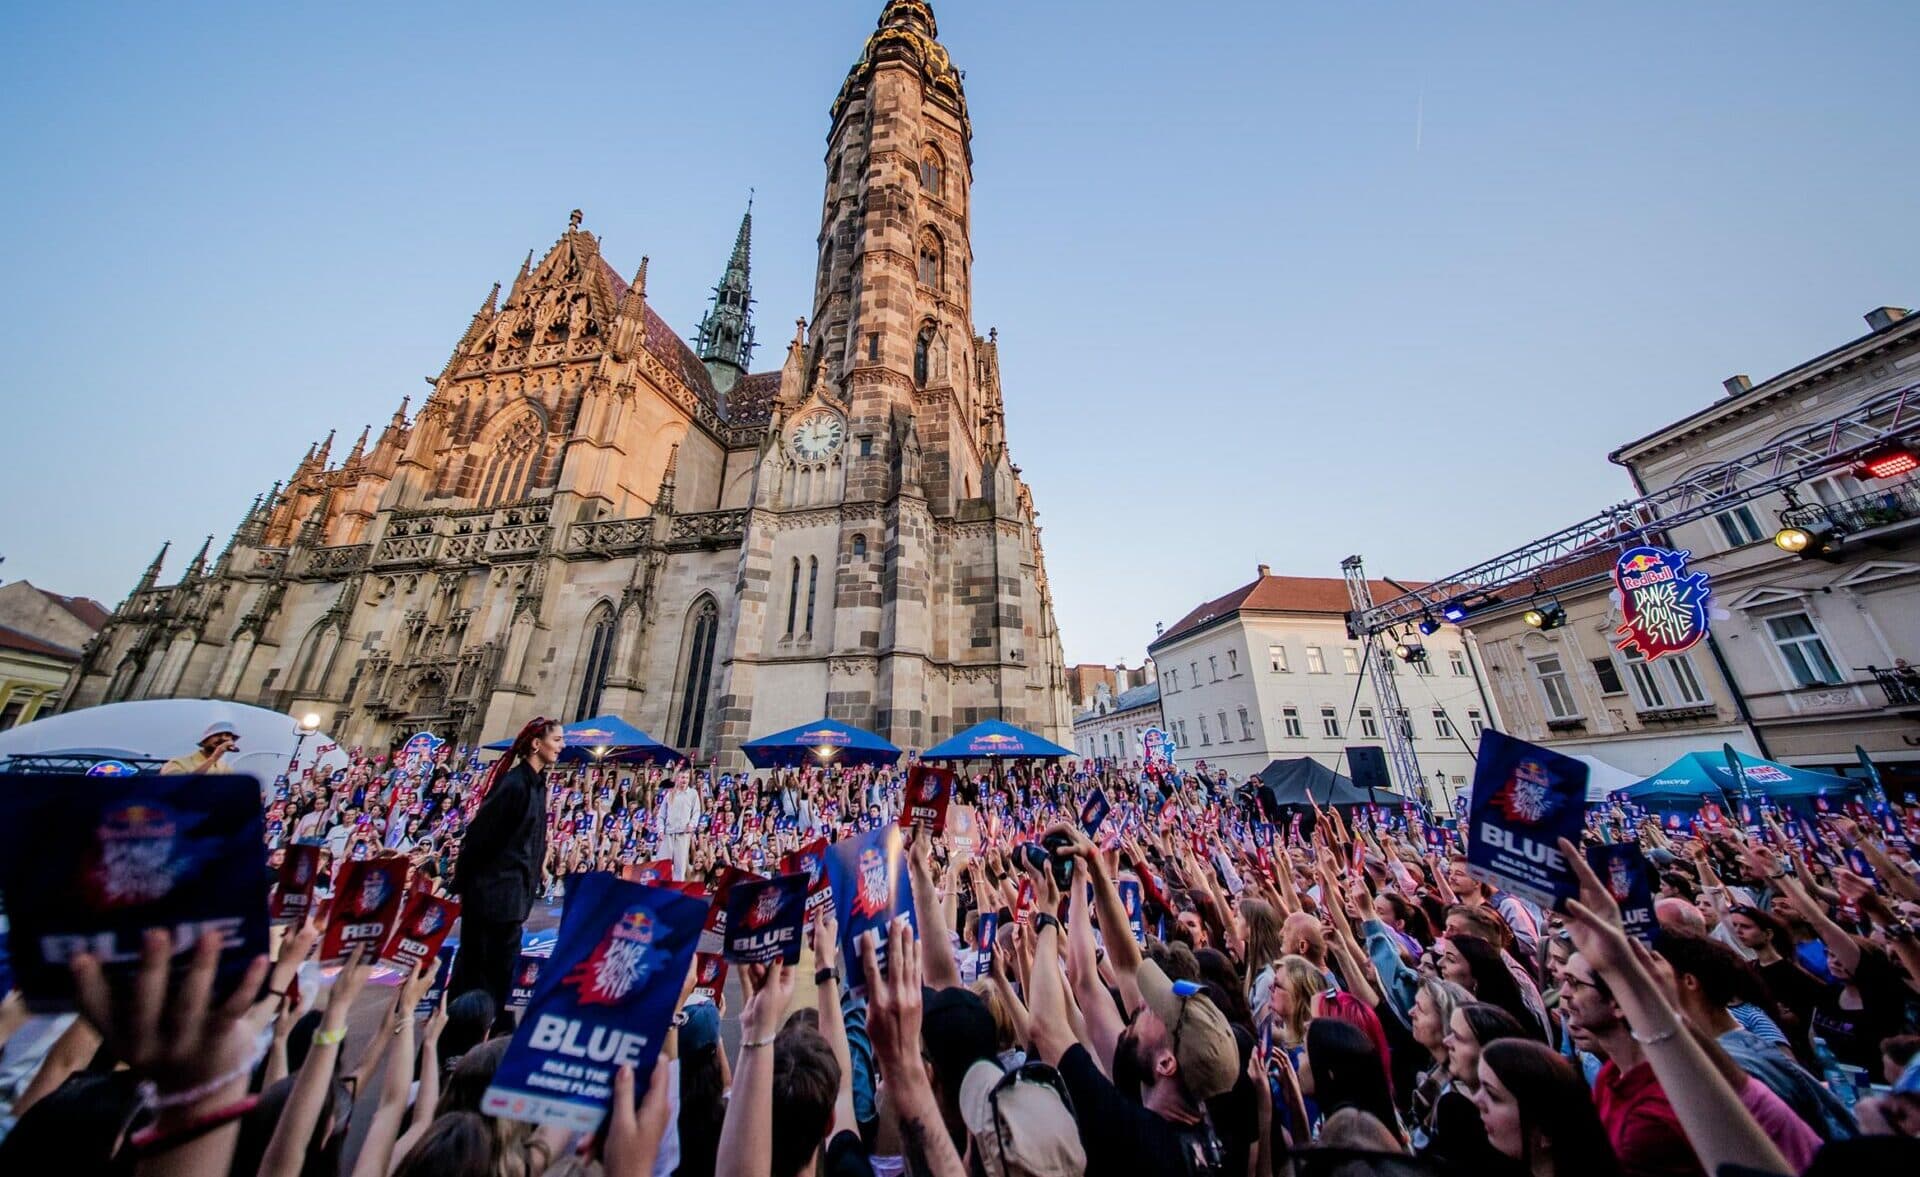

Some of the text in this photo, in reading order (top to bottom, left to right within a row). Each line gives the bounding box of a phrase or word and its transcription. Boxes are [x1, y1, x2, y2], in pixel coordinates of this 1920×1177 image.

[1622, 565, 1674, 590] Red Bull
[1633, 581, 1678, 612] DANCE
[1641, 596, 1693, 628] YOUR
[1647, 612, 1693, 645] STYLE
[969, 743, 1025, 751] Red Bull
[910, 806, 938, 819] RED
[1480, 822, 1567, 874] BLUE
[282, 893, 308, 906] RED
[804, 886, 834, 911] RED
[340, 922, 384, 941] RED
[732, 926, 795, 951] BLUE
[398, 938, 429, 957] RED
[512, 988, 535, 998] BLU
[528, 1013, 647, 1069] BLUE
